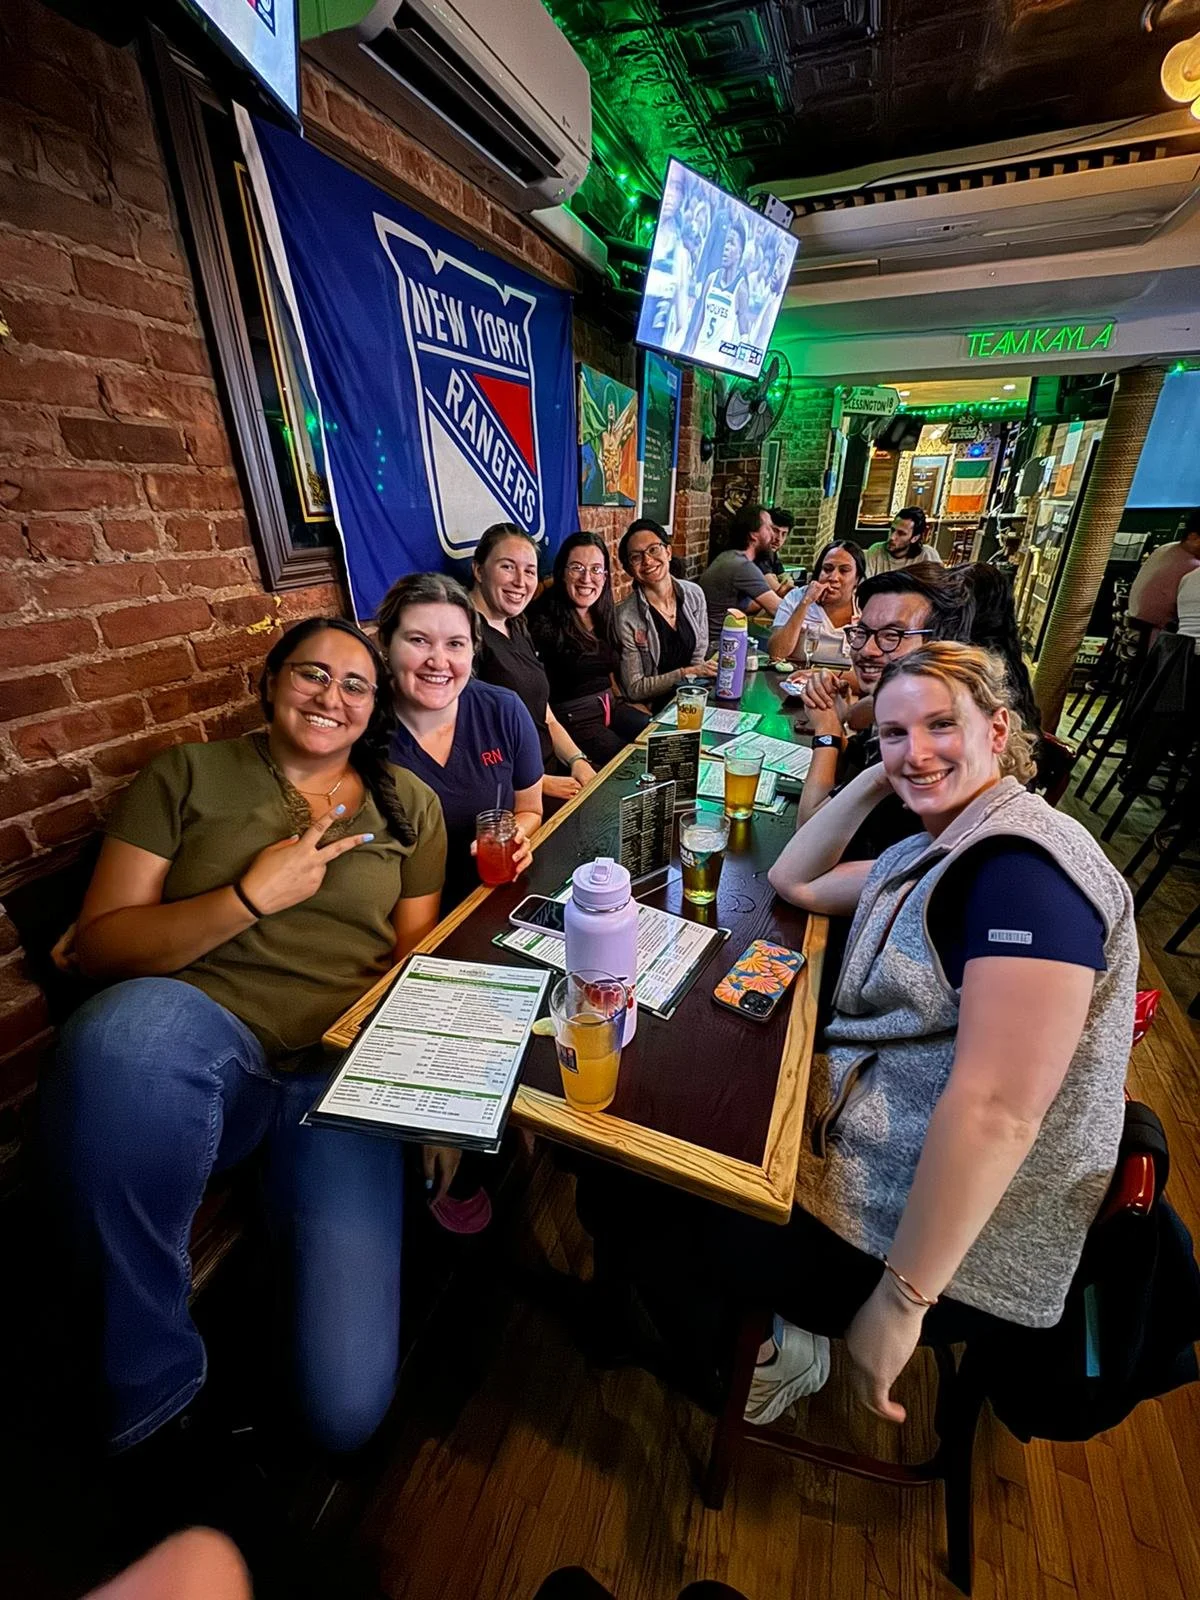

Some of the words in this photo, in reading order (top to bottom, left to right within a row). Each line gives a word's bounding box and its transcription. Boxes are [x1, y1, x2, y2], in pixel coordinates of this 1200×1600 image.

[408, 277, 468, 349] NEW
[470, 304, 527, 367] YORK
[707, 317, 717, 339] 5
[967, 329, 1031, 358] TEAM
[1032, 323, 1114, 353] KAYLA
[445, 368, 536, 523] RANGERS
[481, 747, 504, 767] RN
